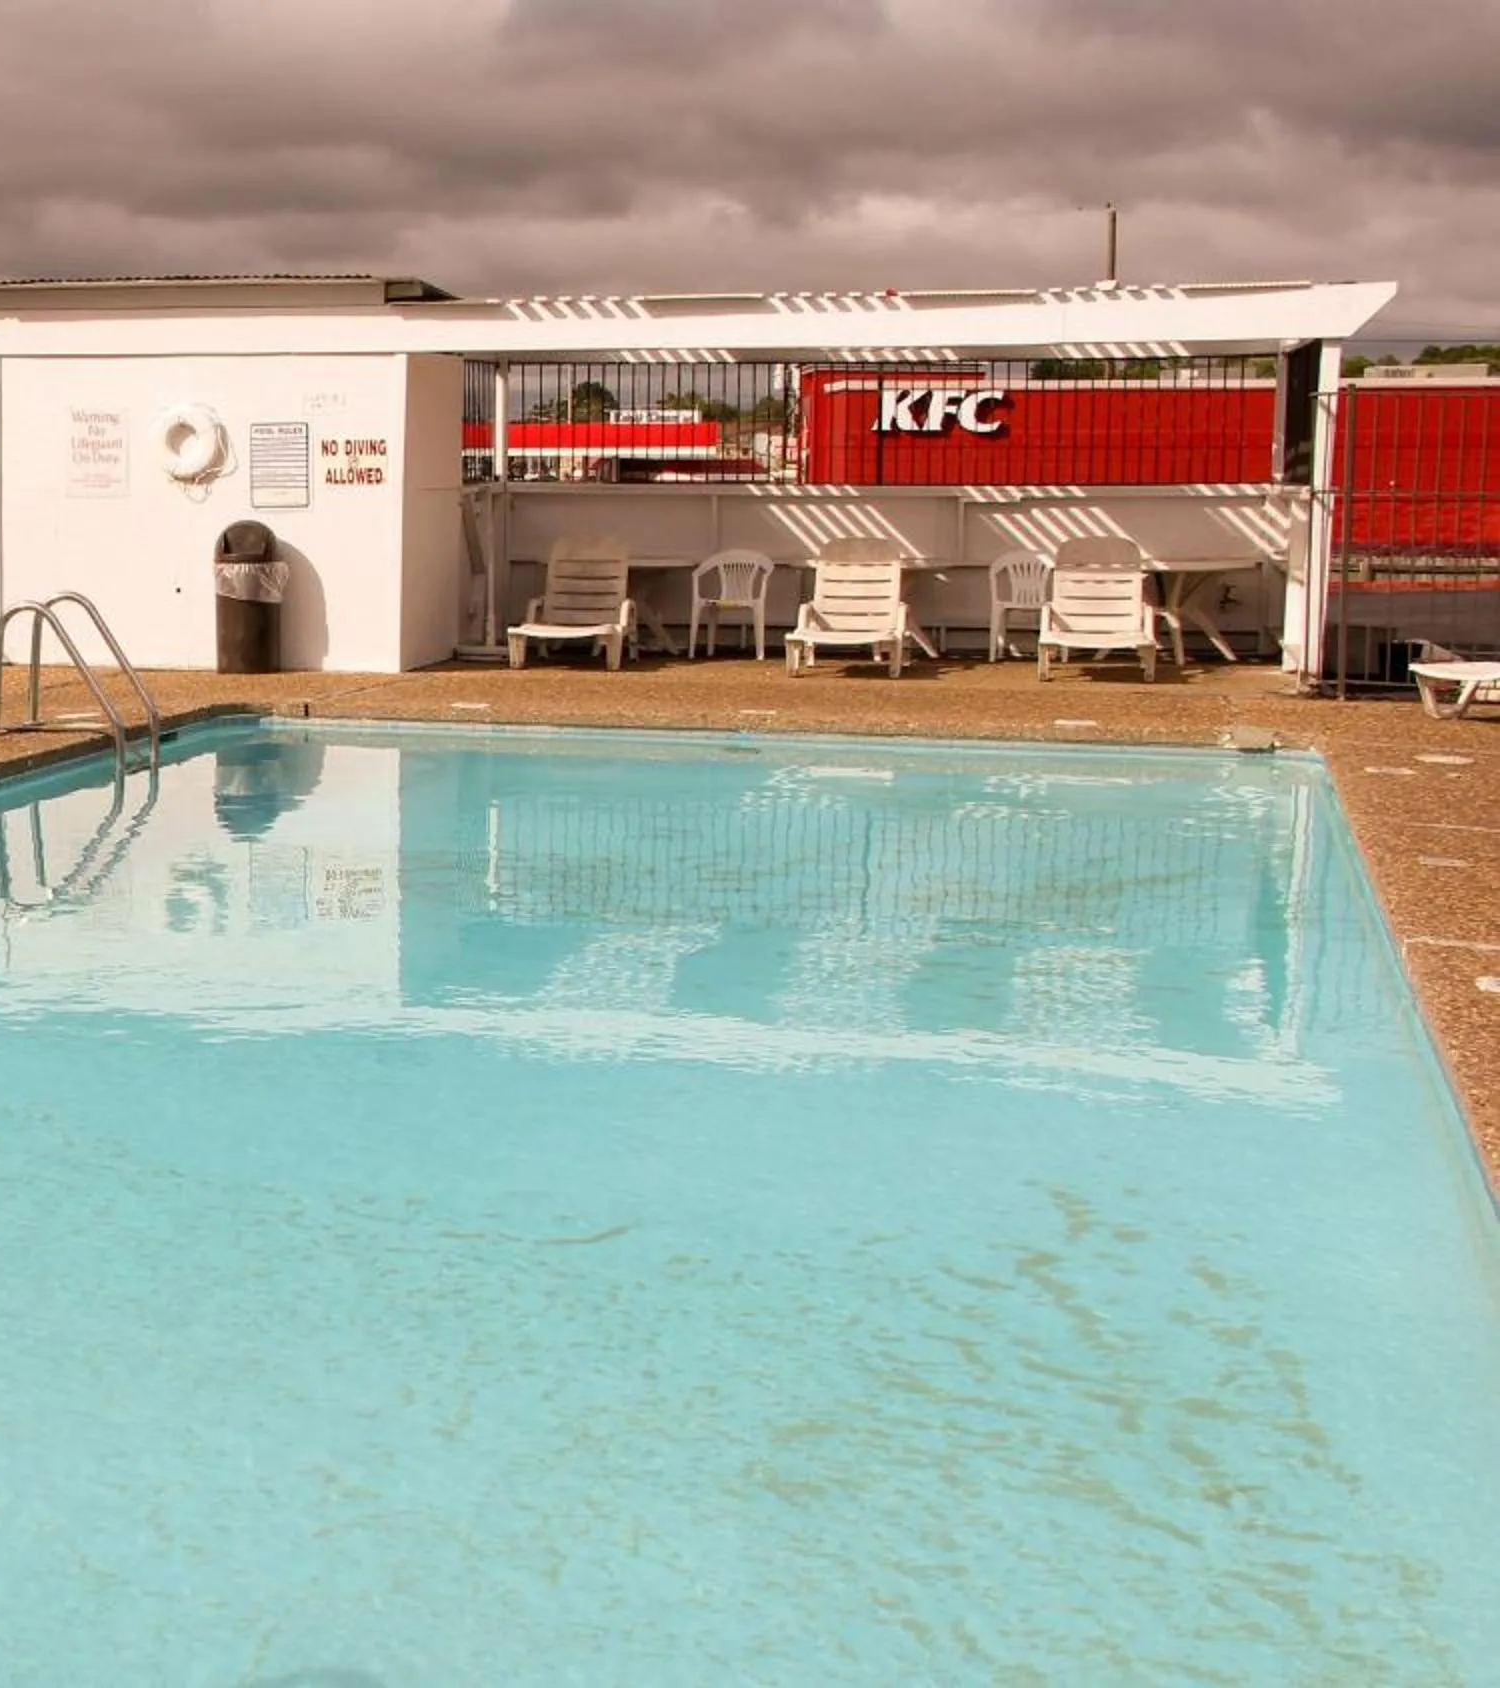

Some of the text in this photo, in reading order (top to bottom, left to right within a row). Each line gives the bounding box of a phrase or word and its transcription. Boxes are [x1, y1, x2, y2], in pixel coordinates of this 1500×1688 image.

[871, 389, 1006, 432] KFC
[321, 439, 387, 456] NO DIVING
